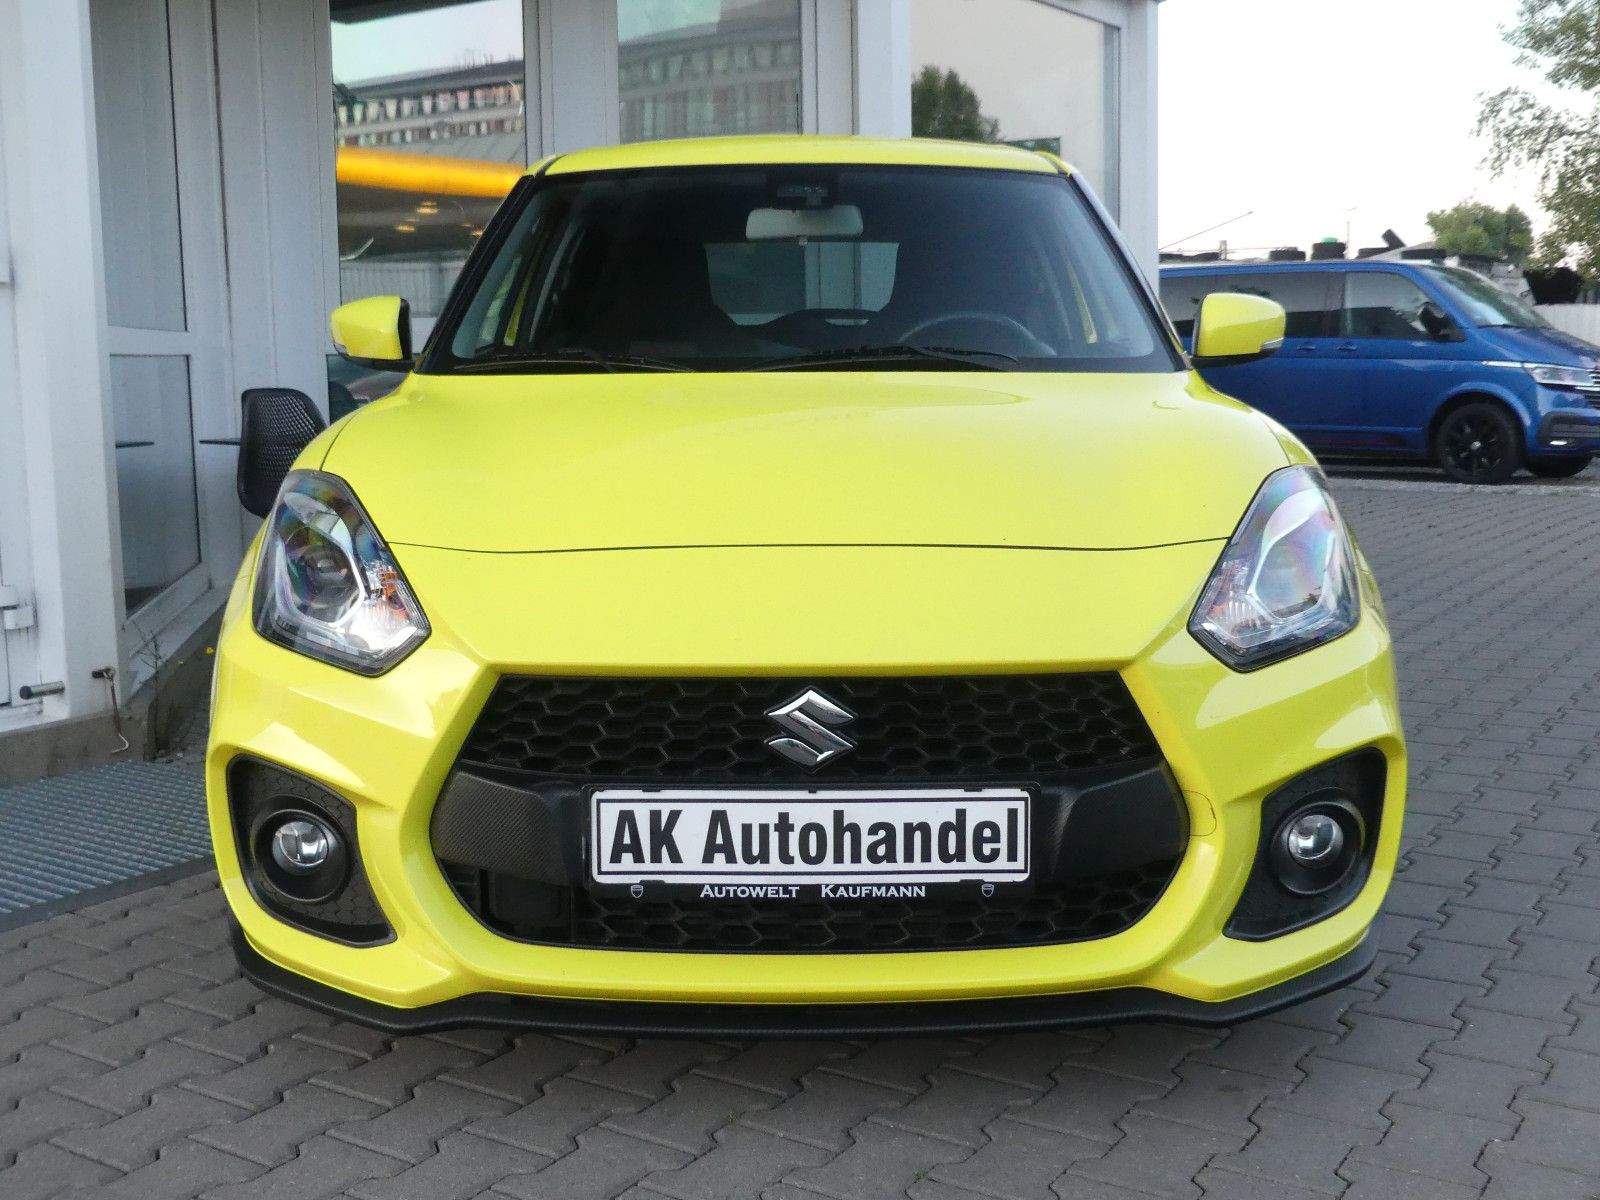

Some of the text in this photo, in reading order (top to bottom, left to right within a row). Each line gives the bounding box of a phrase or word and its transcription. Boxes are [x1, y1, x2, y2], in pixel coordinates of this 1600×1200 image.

[608, 807, 1019, 864] AK Autohandel
[699, 884, 926, 898] AUTOWELT KAUFMANN
